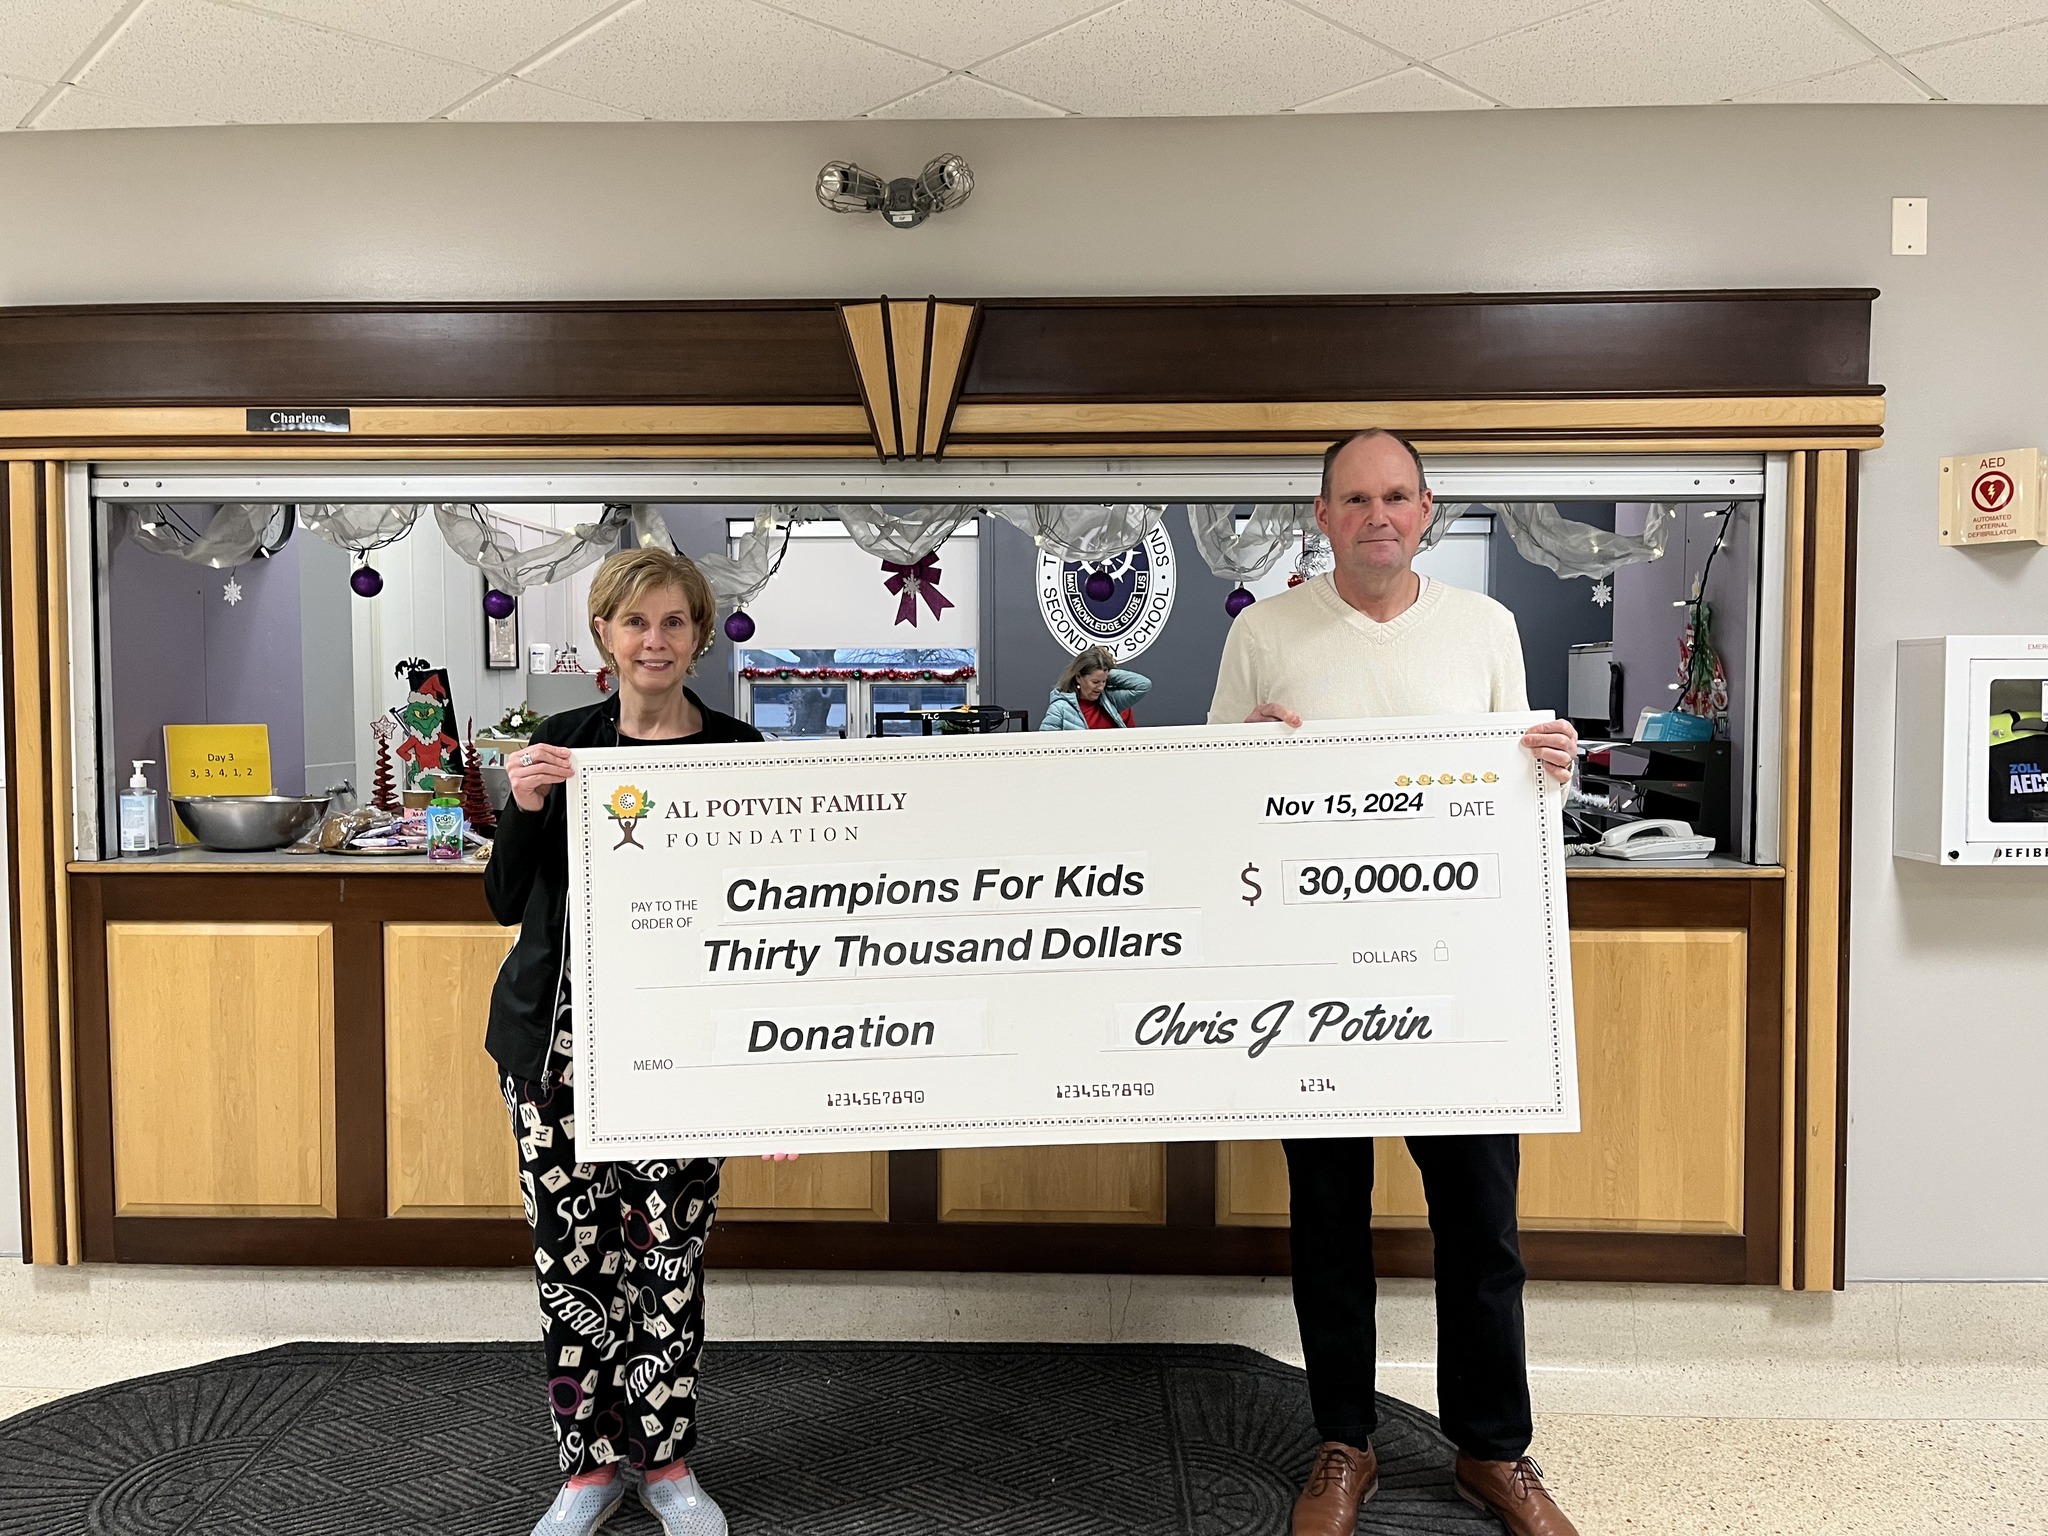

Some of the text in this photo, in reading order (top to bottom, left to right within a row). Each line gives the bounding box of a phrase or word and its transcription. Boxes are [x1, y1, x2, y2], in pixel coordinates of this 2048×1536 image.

[269, 412, 326, 424] Charlene
[1980, 457, 2006, 469] AED
[1972, 514, 2012, 523] AUTOMATED
[1967, 529, 2017, 538] DEFIBRILLATOR
[1975, 522, 2009, 531] EXTERNAL
[1066, 573, 1147, 632] MAY KNOWLEDGE GUIDE US
[1043, 587, 1170, 658] SECONDY SCHOOL
[207, 753, 235, 763] Day 3
[190, 768, 253, 778] 3, 3, 4, 1, 2
[2009, 763, 2041, 774] ZOLL
[664, 792, 908, 819] AL POTVIN FAMILY
[1265, 792, 1424, 817] Nov 15, 2024
[1449, 801, 1495, 817] DATE
[666, 826, 859, 848] FOUNDATION
[726, 864, 1145, 914] Champions For Kids
[1240, 861, 1479, 907] $ 30,000.00
[631, 899, 698, 913] PAY TO THE
[631, 917, 693, 930] ORDER OF
[704, 926, 1183, 977] Thirty Thousand Dollars
[1352, 950, 1418, 964] DOLLARS
[1135, 1002, 1239, 1046] Chris
[1308, 1001, 1433, 1043] Potvin
[748, 1015, 935, 1053] Donation
[633, 1059, 674, 1071] MEMO
[827, 1078, 1336, 1107] 1234567890 1234567890 1234
